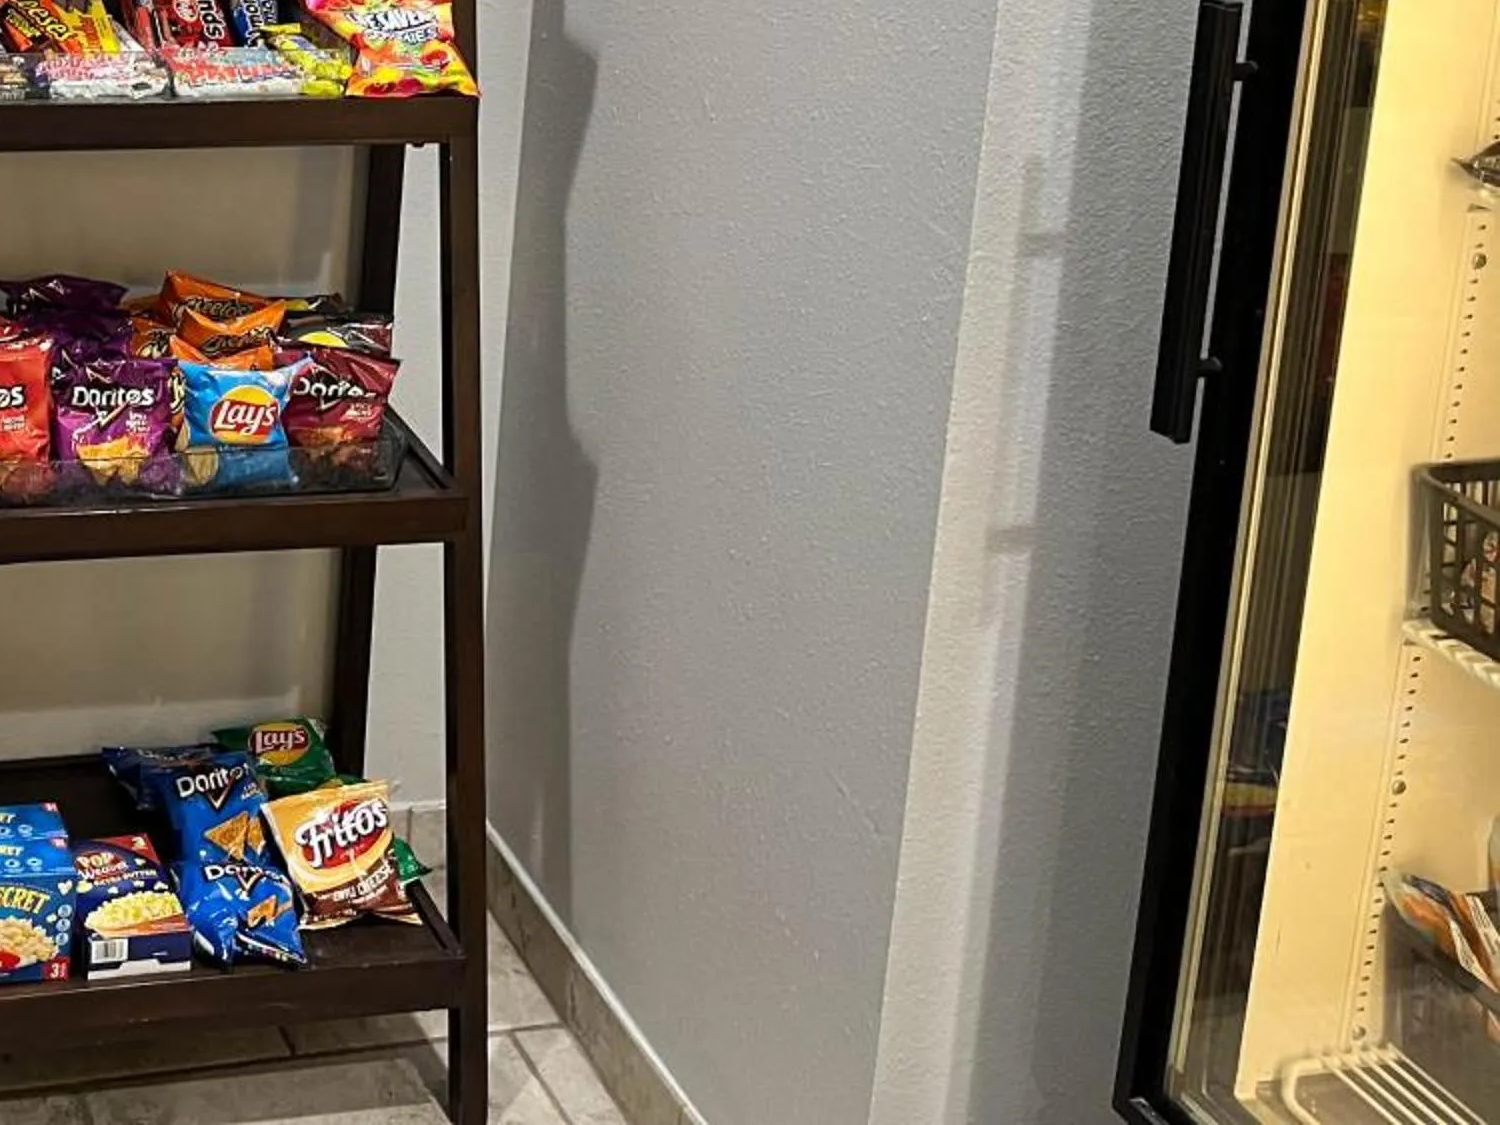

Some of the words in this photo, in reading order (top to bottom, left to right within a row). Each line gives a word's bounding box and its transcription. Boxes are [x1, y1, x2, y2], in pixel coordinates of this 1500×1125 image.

[72, 386, 155, 407] Doritos
[213, 399, 276, 435] Lay's
[254, 727, 307, 753] Lay's
[295, 798, 388, 868] Fritos
[75, 851, 115, 869] POP
[49, 962, 60, 979] 3
